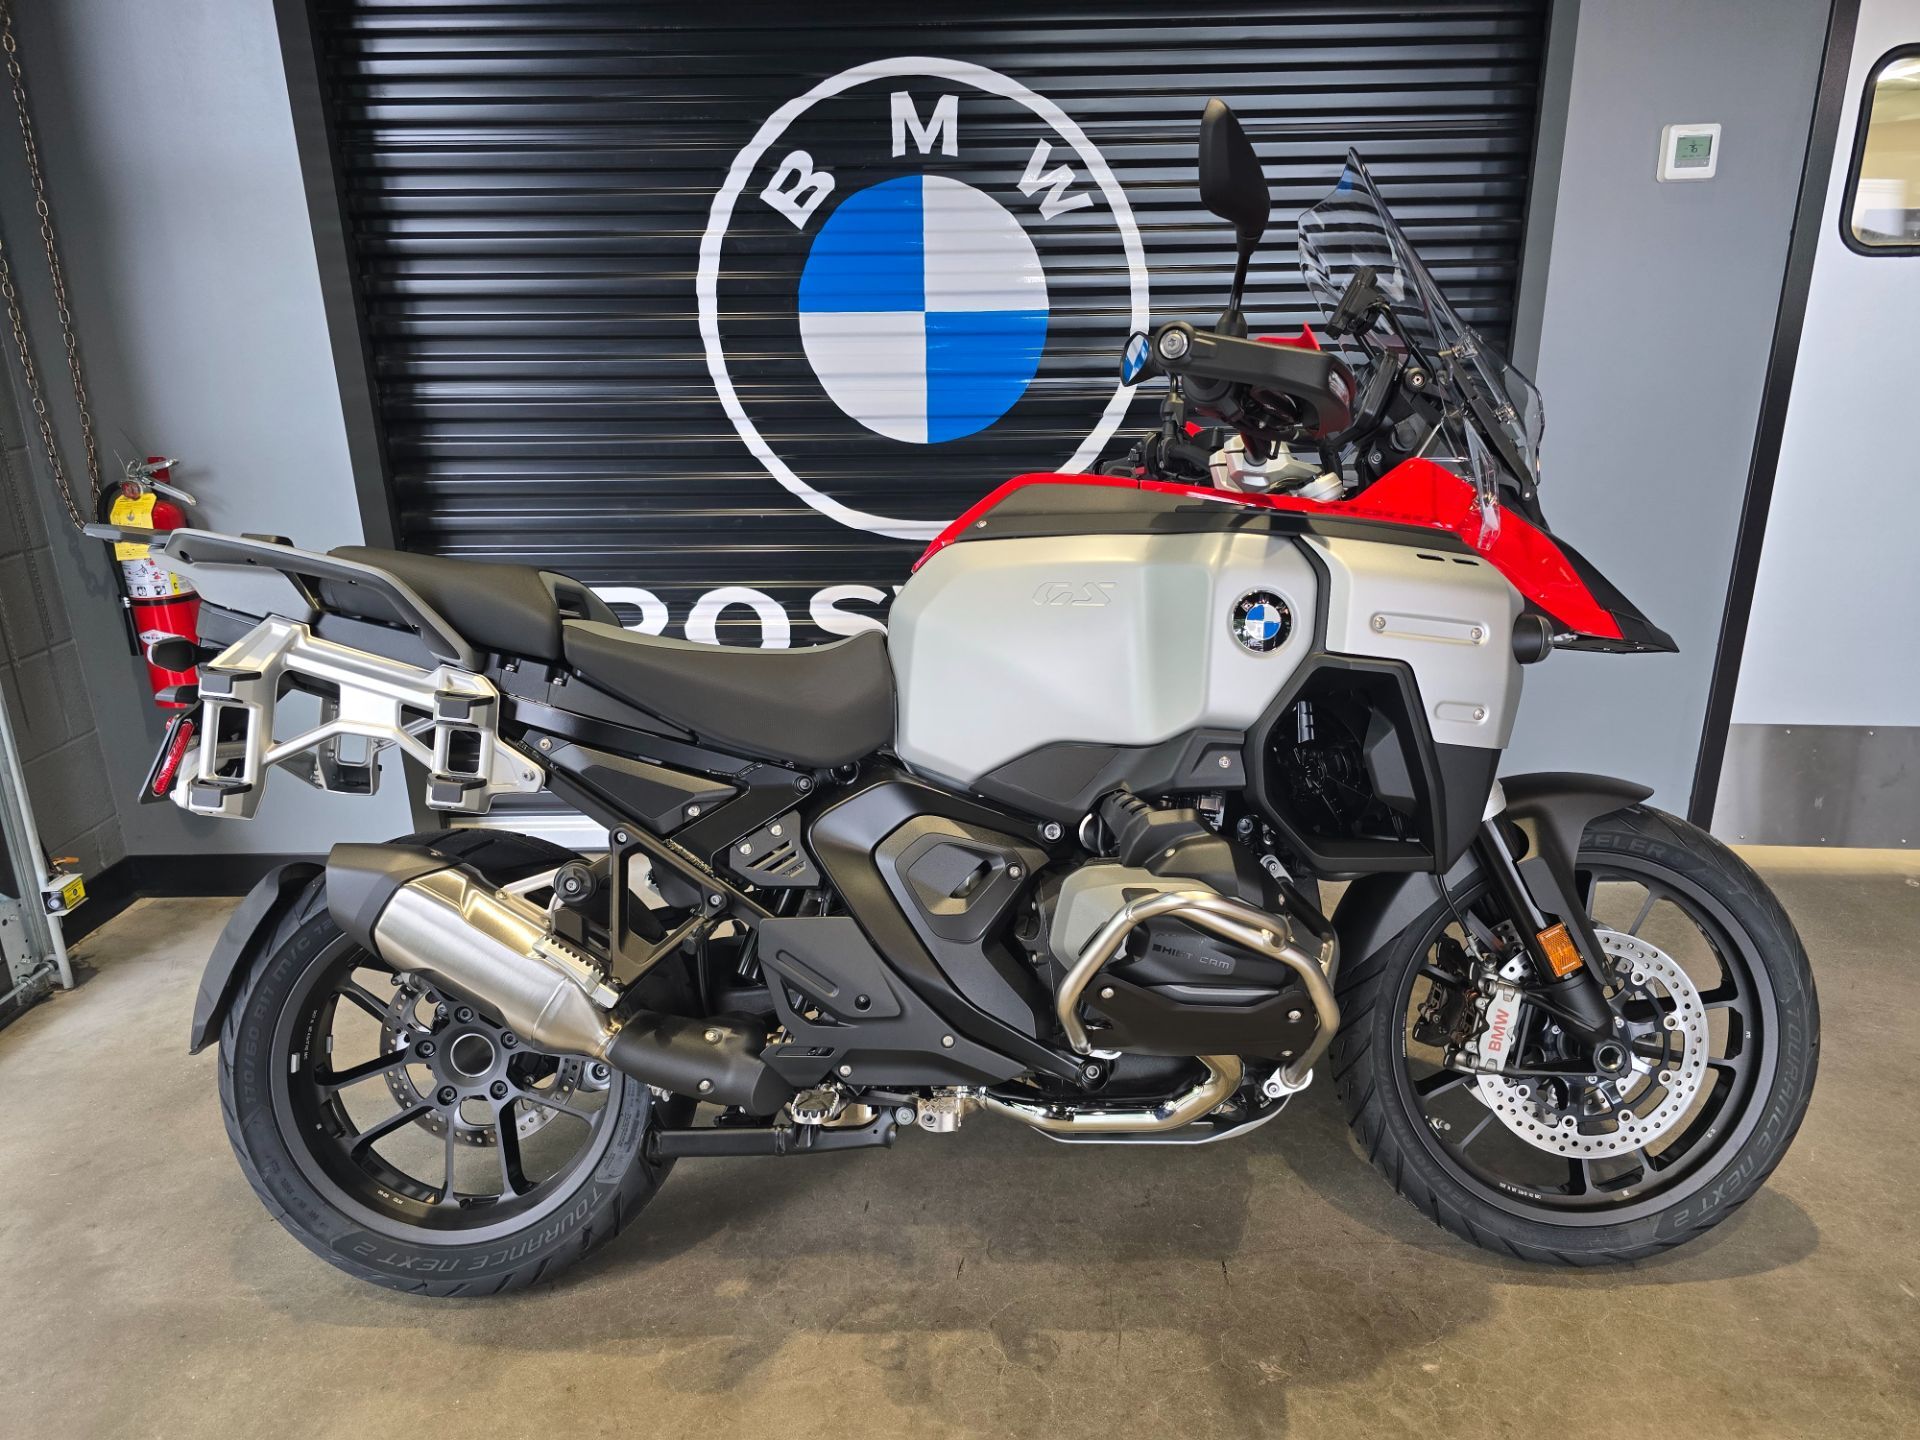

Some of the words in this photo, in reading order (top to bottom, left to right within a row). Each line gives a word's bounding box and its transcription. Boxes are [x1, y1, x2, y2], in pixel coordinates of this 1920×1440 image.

[760, 91, 1094, 230] BMW
[1032, 581, 1117, 607] GS
[588, 584, 904, 650] OS
[1580, 833, 1667, 860] ZELER
[1487, 1008, 1510, 1052] BMW
[1757, 1005, 1801, 1154] TOURANCE
[467, 1186, 602, 1271] TOURANCE
[1673, 1208, 1690, 1228] 2
[353, 1241, 377, 1256] 2
